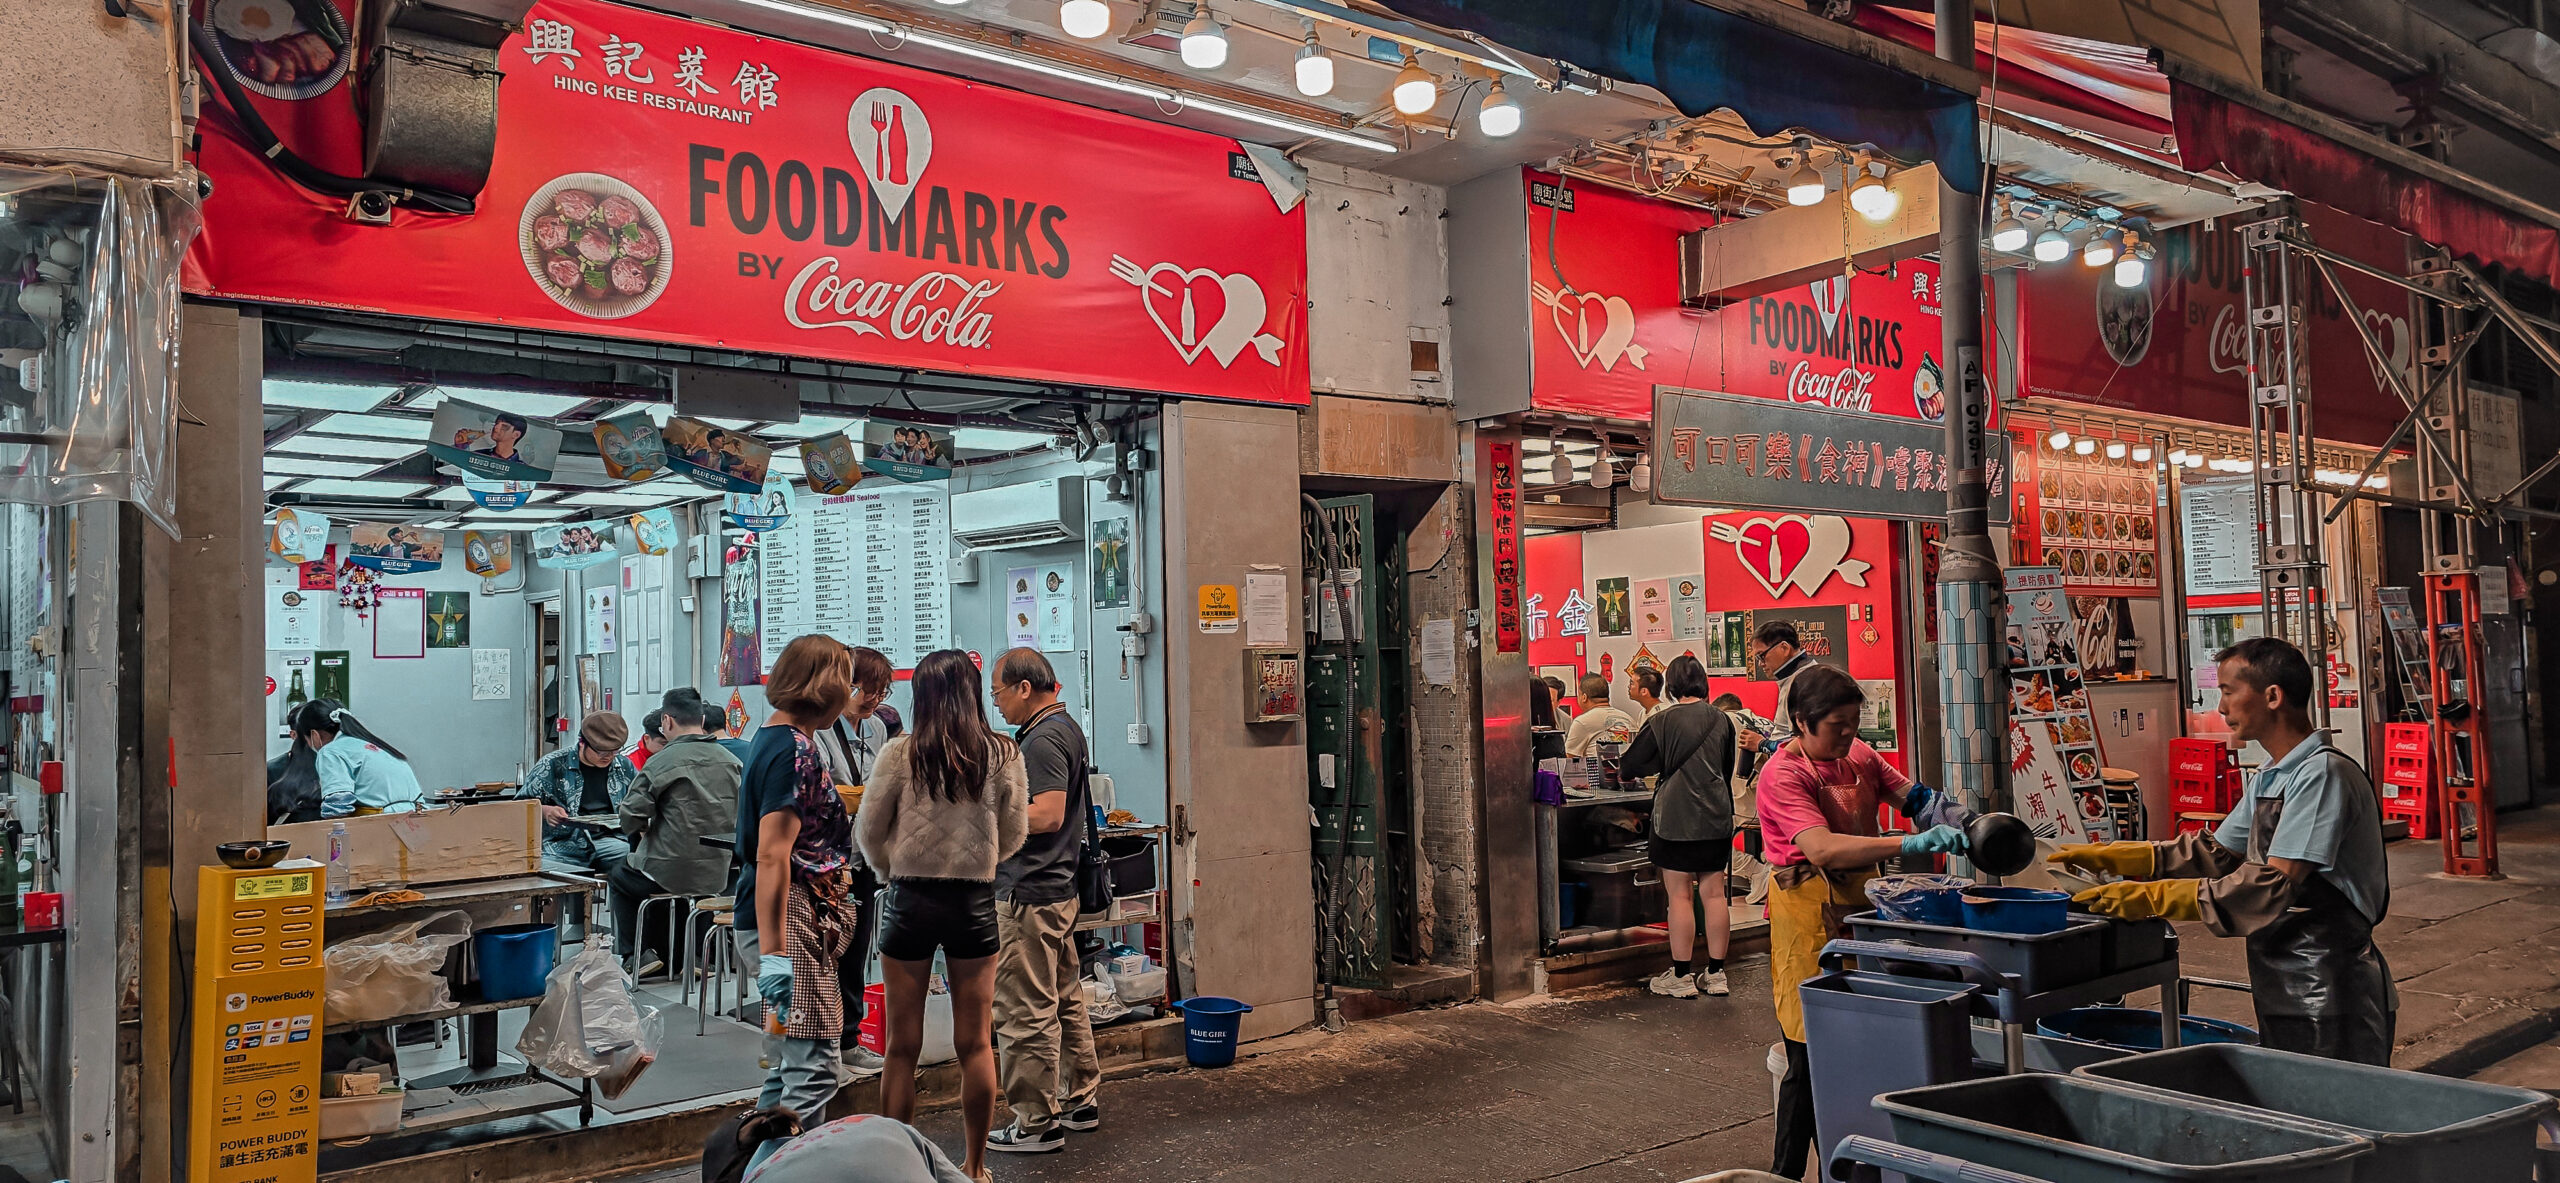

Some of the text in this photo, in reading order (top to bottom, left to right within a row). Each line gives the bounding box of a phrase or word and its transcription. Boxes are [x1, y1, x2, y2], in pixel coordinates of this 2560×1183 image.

[523, 19, 780, 112] 興記菜館
[554, 75, 753, 125] HING KEE RESTAURANT
[1533, 183, 1574, 204] 廟街1號
[688, 142, 1070, 280] FOODMARKS
[738, 250, 783, 280] BY
[223, 291, 260, 301] registered
[261, 295, 298, 304] trademark
[783, 256, 1006, 349] Coca-Cola
[1920, 304, 1929, 315] HING
[1750, 295, 1904, 370] FOODMARKS
[1769, 360, 1788, 377] BY
[1788, 360, 1876, 413] Coca-Cola
[2180, 762, 2203, 771] Coca-Cola
[2180, 795, 2203, 804] Coca-Cola
[251, 989, 315, 1004] PowerBuddy
[1190, 1028, 1208, 1038] BLUE
[220, 1129, 308, 1152] POWER BUDDY
[220, 1142, 308, 1168] 讓生活充滿電
